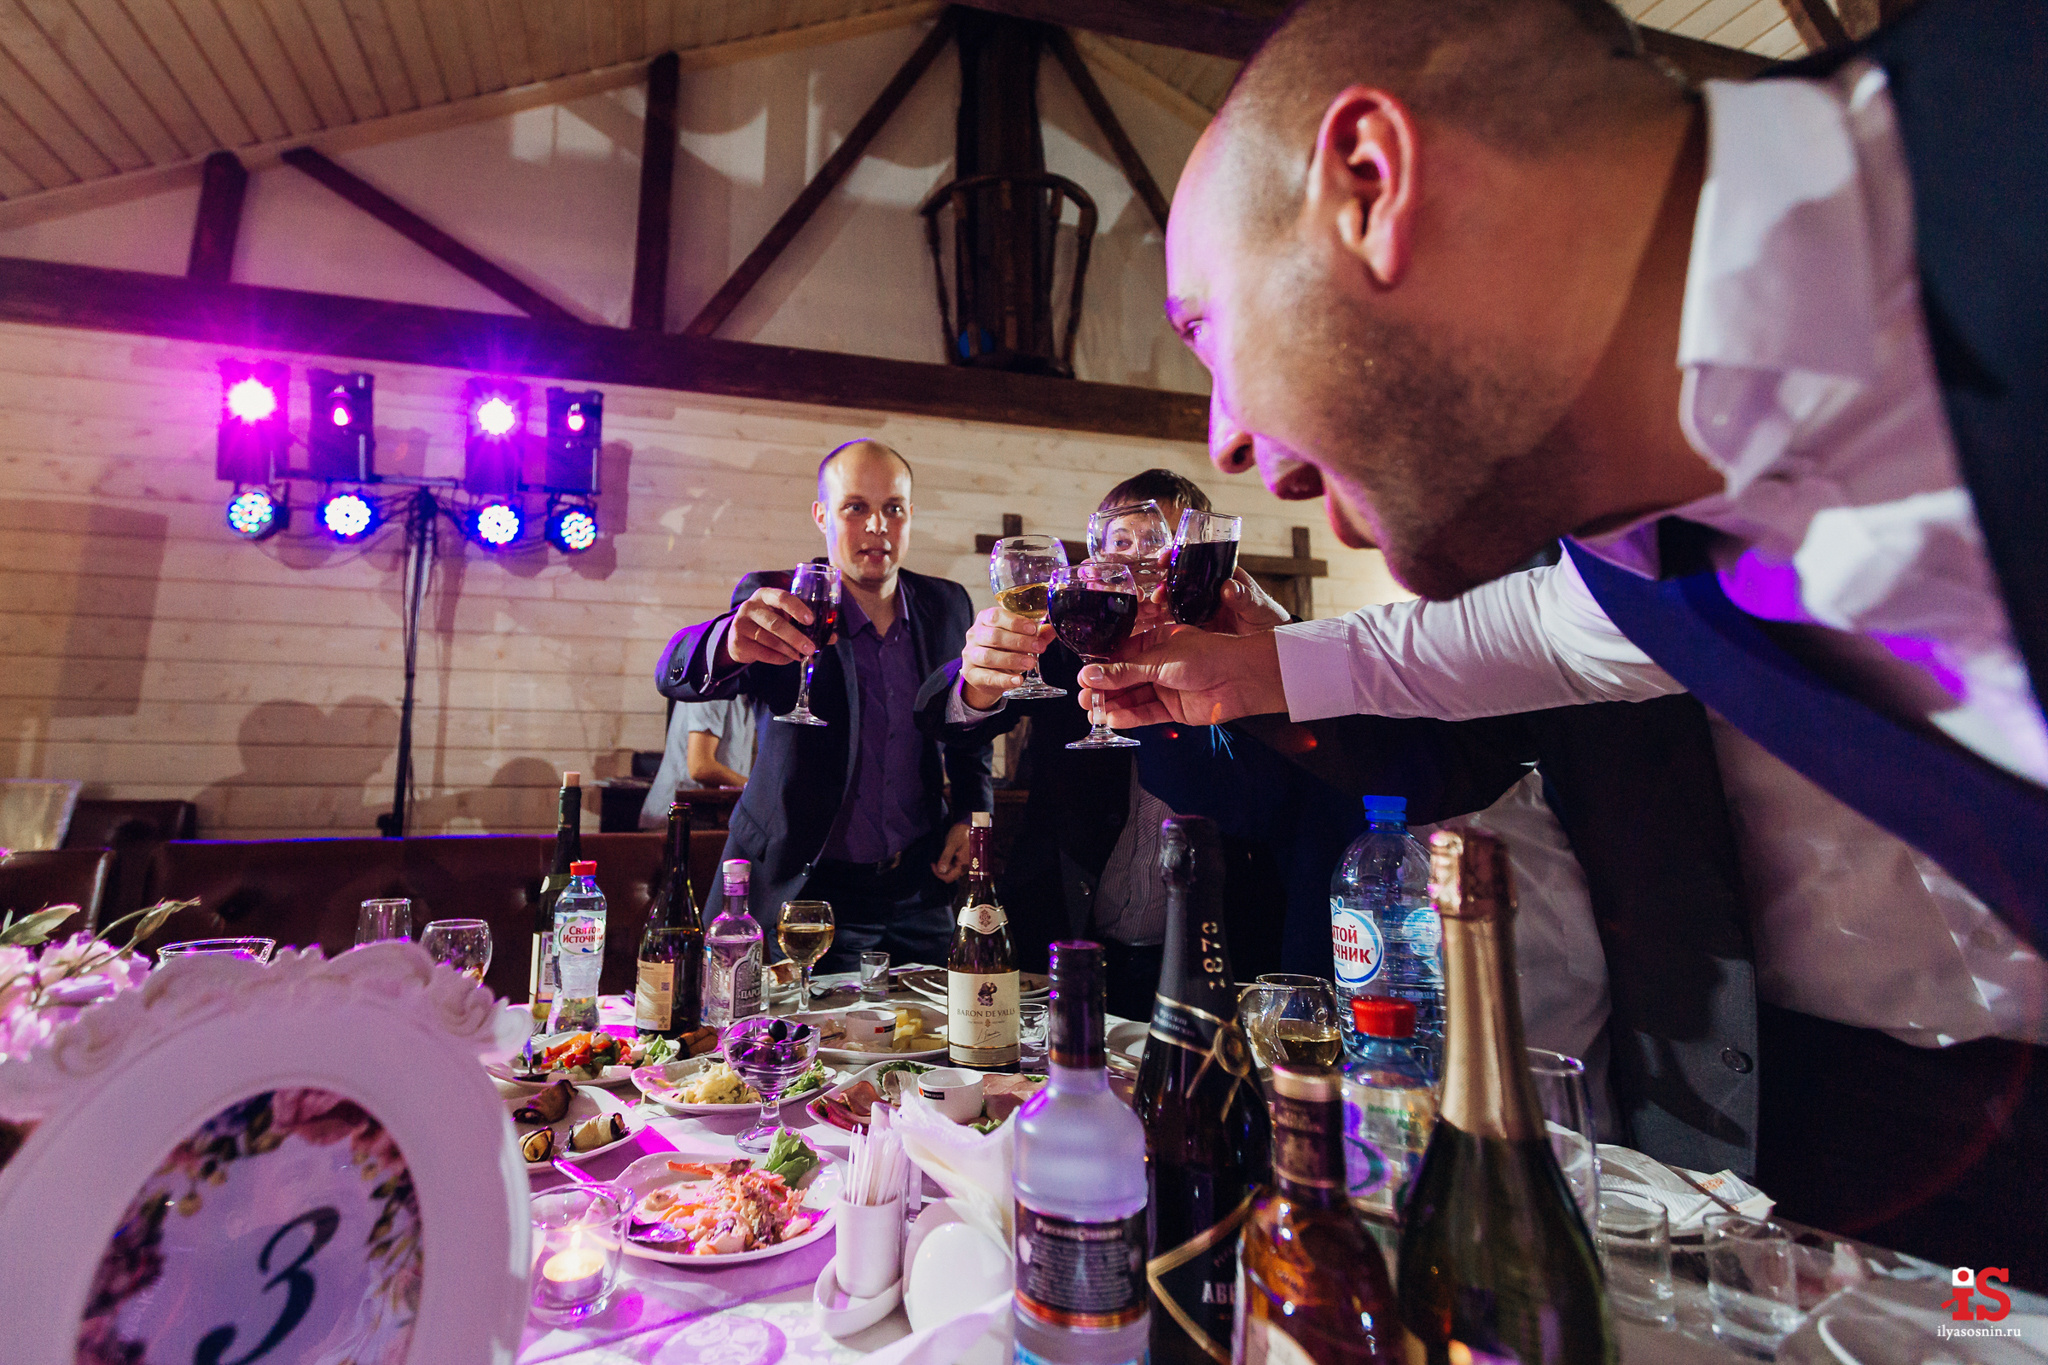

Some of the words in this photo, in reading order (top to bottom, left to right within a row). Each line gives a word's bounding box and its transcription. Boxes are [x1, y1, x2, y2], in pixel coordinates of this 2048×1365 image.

[956, 1008, 983, 1017] BARON
[985, 1010, 996, 1018] DE
[194, 1206, 341, 1365] 3
